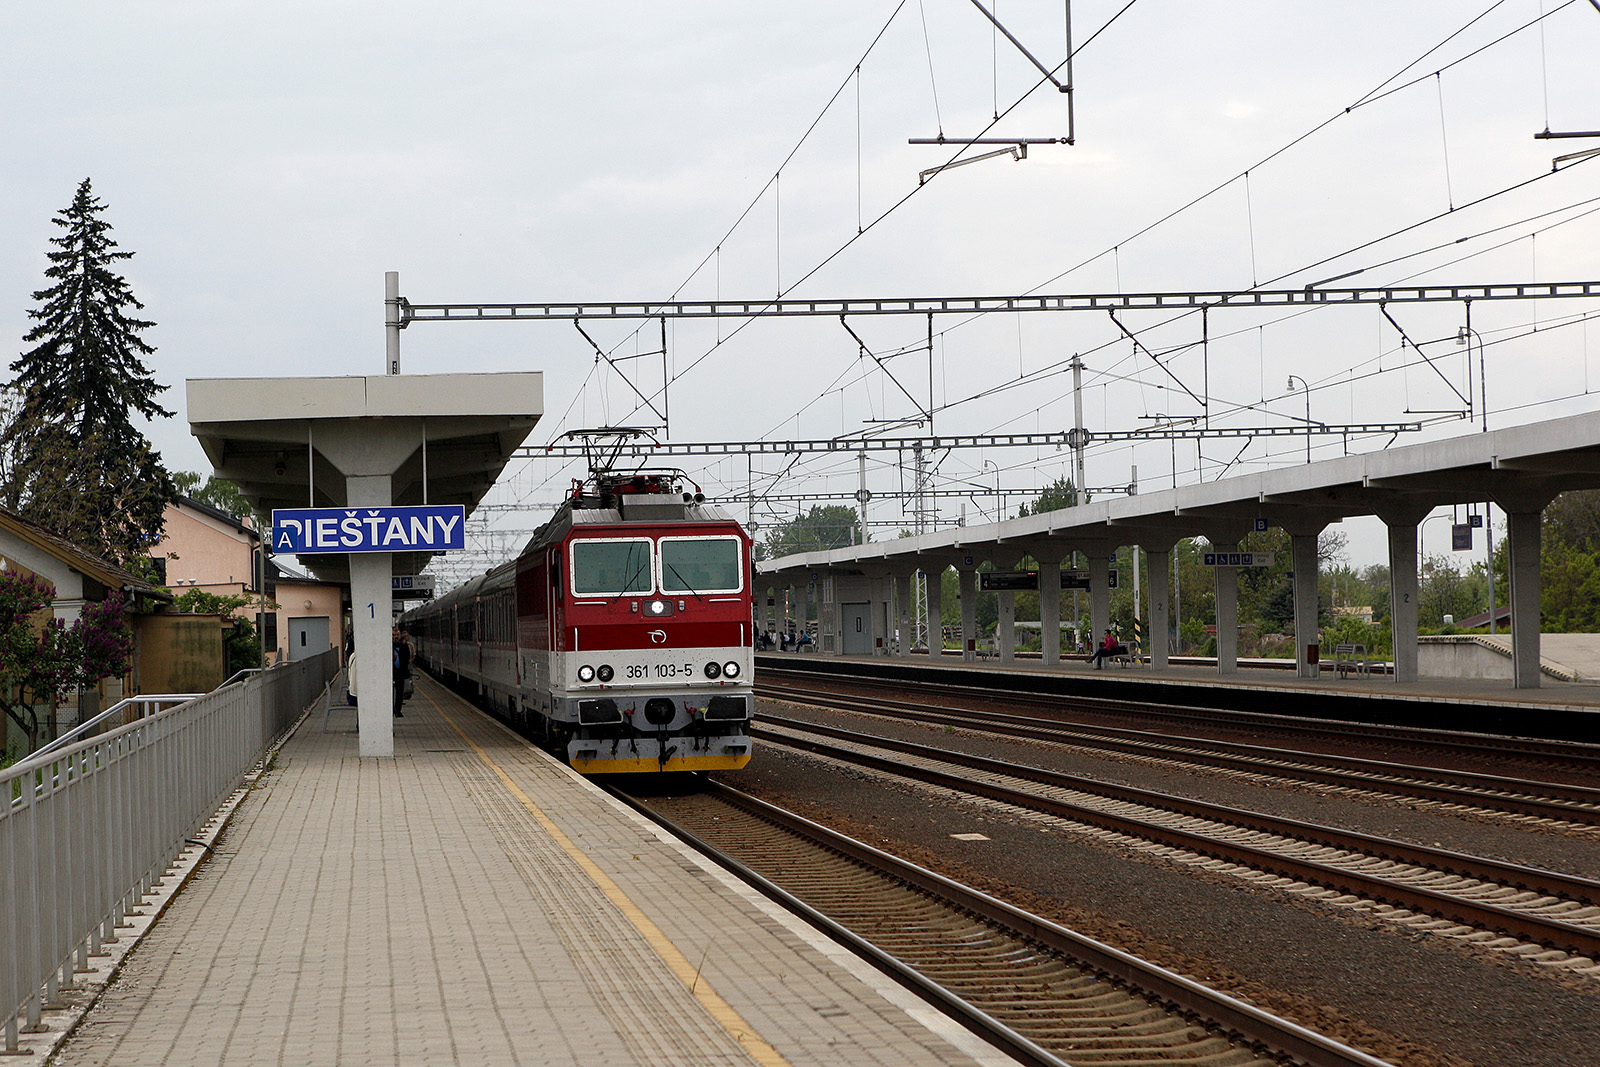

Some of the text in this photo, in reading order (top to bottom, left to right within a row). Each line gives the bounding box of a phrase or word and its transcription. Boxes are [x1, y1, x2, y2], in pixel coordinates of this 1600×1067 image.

[1257, 520, 1265, 530] B
[1473, 517, 1480, 526] B
[277, 531, 293, 549] A
[1109, 577, 1115, 585] 6
[424, 588, 430, 596] 3
[1403, 593, 1409, 603] 2
[367, 603, 375, 619] 1
[1157, 603, 1163, 611] 2
[626, 663, 693, 679] 361 103-5
